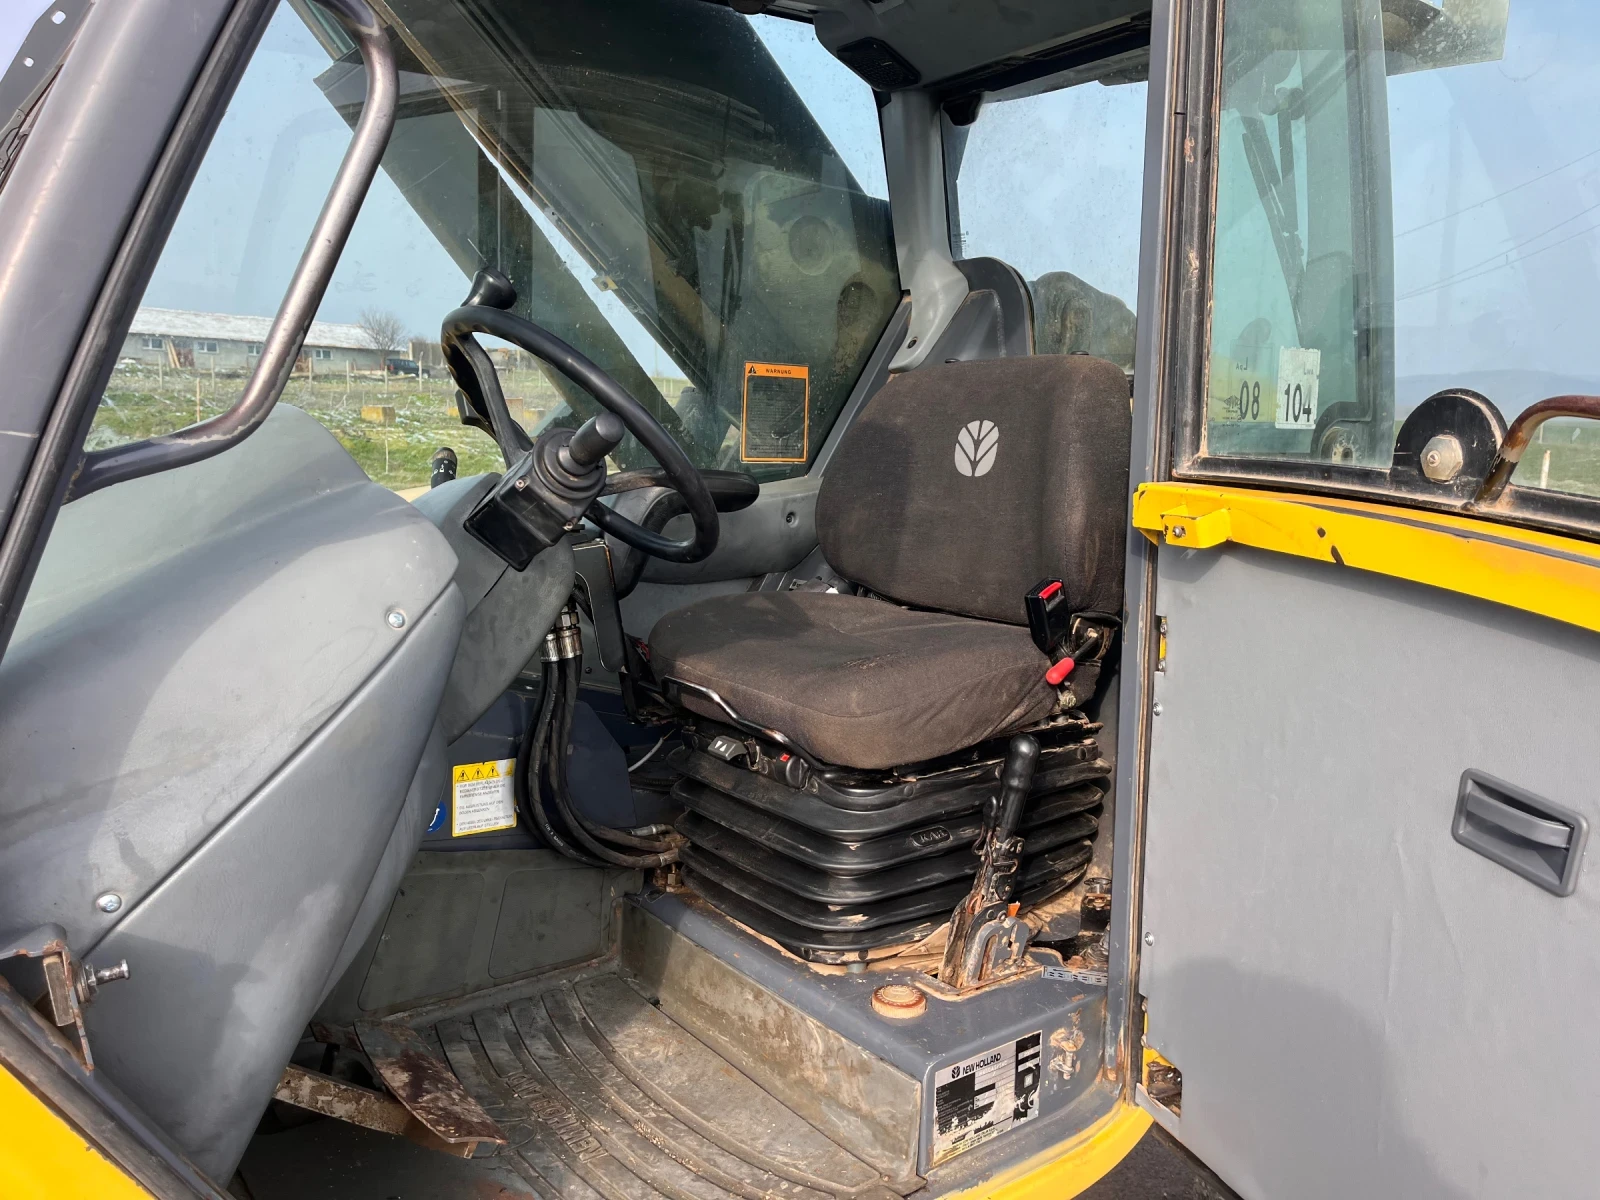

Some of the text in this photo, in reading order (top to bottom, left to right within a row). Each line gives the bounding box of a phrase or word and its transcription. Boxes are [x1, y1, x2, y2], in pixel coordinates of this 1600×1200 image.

[1284, 383, 1312, 422] 104
[962, 1065, 976, 1075] NEW
[975, 1053, 1001, 1069] HOLLAND
